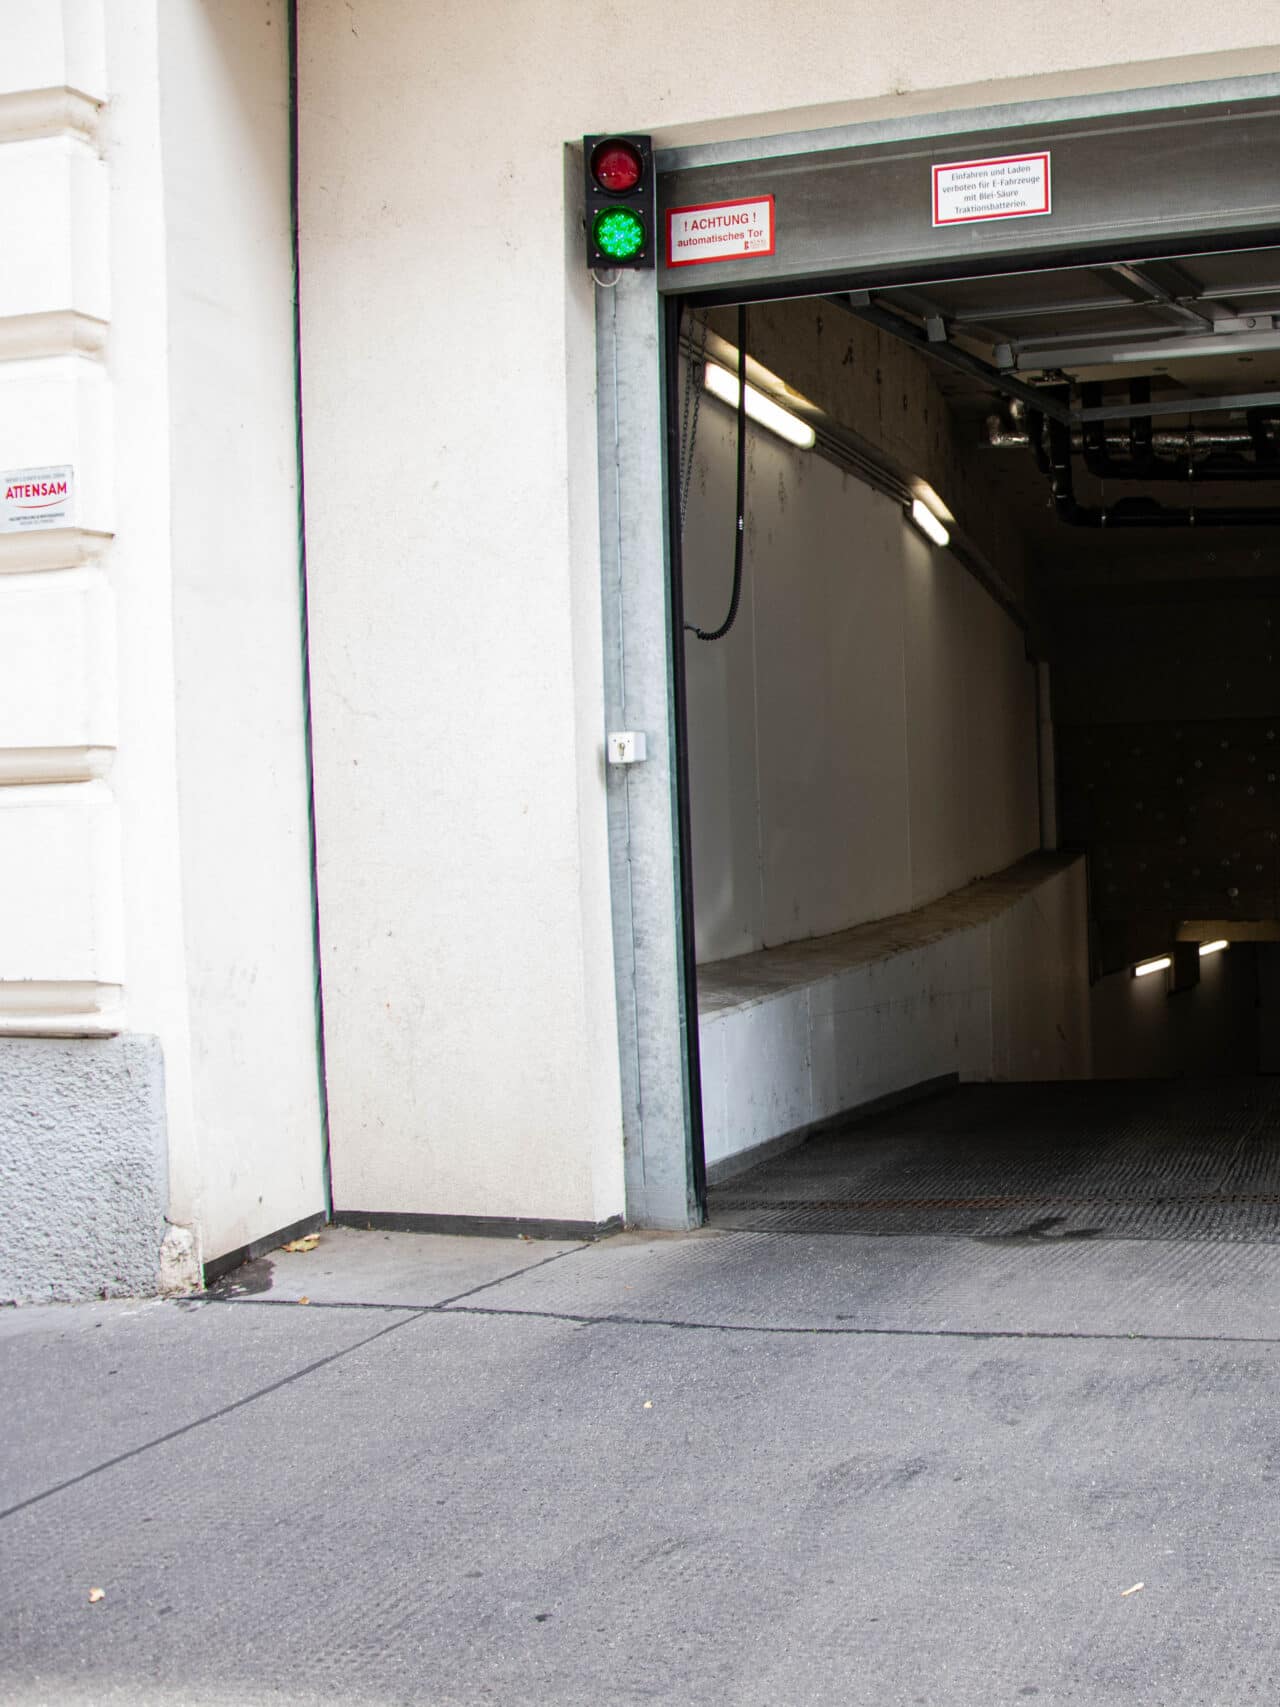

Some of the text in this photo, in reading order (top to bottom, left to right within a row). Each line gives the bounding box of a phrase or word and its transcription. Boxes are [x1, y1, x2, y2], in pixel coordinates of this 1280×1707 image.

[951, 165, 1031, 181] Einfahren und Laden
[942, 176, 1041, 193] verboten für E-Fahrzeuge
[964, 193, 976, 202] mit
[691, 213, 748, 231] ACHTUNG
[677, 231, 744, 248] automatisches
[747, 229, 763, 238] Tor
[5, 481, 67, 500] ATTENSAM
